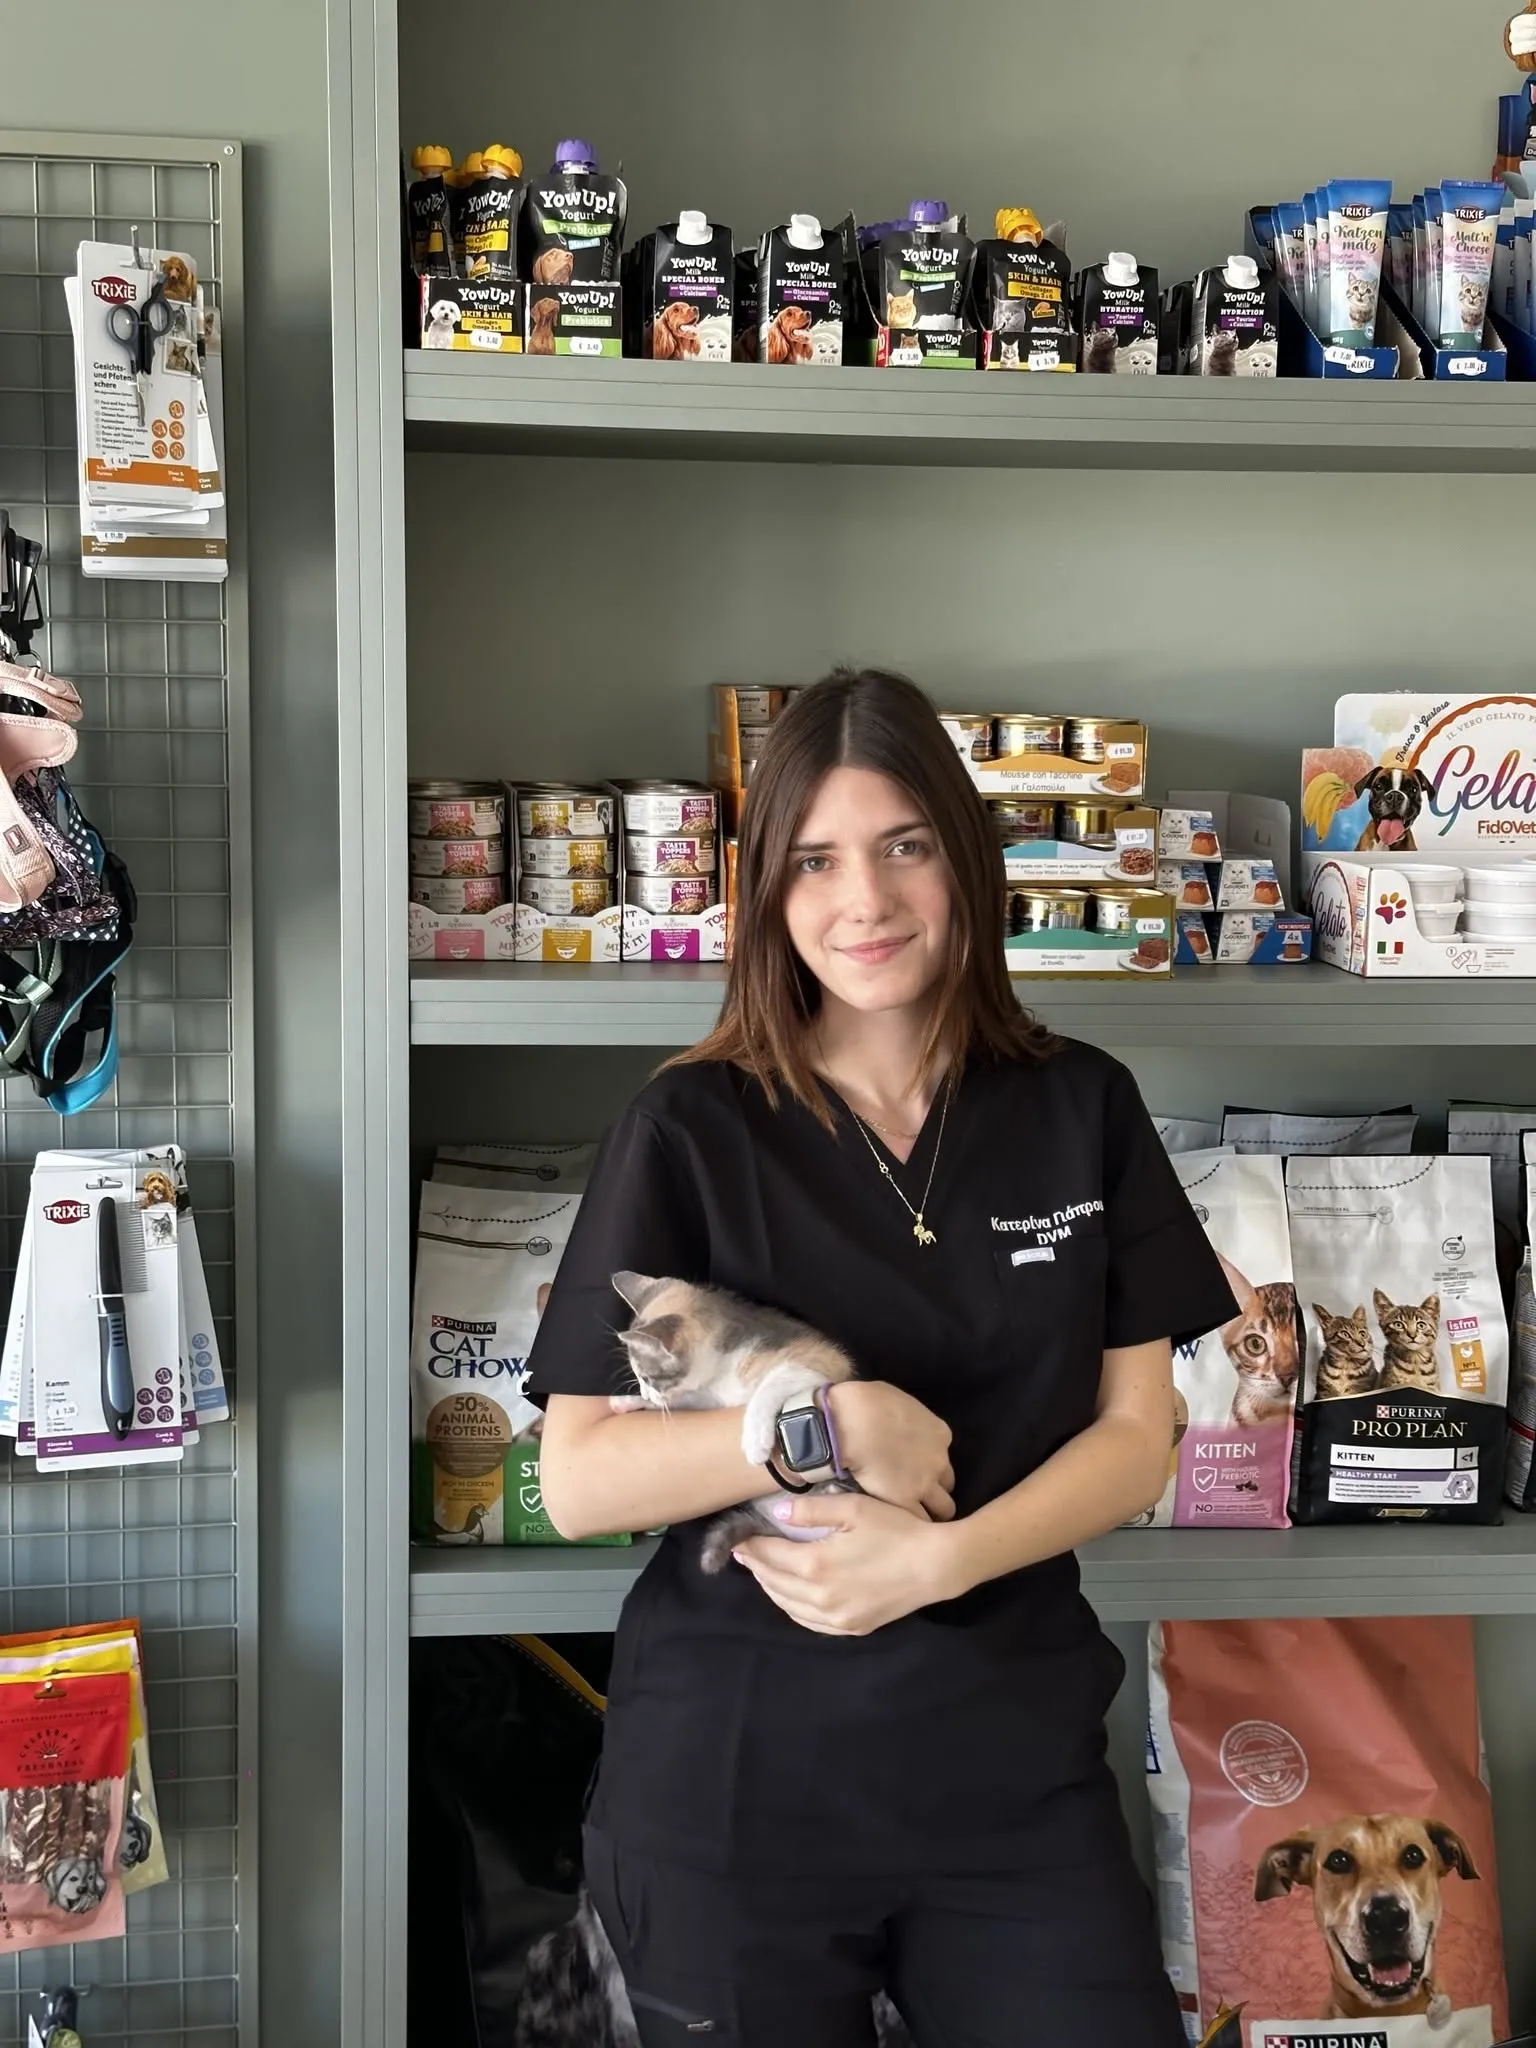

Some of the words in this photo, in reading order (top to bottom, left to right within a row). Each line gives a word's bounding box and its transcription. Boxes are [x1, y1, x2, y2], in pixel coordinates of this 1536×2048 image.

[468, 188, 514, 213] YowUp!
[540, 188, 616, 214] YowUp!
[560, 209, 595, 222] Yogurt
[1341, 206, 1372, 217] TRIXIE
[1455, 208, 1484, 219] TRIXIE
[1334, 225, 1383, 242] Katzen
[1342, 238, 1379, 254] malz
[1455, 242, 1491, 255] Cheese
[901, 248, 959, 265] YowUp!
[670, 256, 717, 271] YowUp!
[785, 261, 830, 276] YowUp!
[915, 262, 942, 272] Yogurt
[1024, 264, 1048, 275] Yogurt
[662, 275, 696, 283] SPECIAL
[776, 279, 810, 287] SPECIAL
[812, 281, 837, 289] BONES
[1007, 271, 1030, 282] SKIN
[1032, 275, 1039, 283] &
[1040, 276, 1062, 286] HAIR
[458, 287, 515, 306] YowUp!
[558, 290, 615, 309] YowUp!
[717, 294, 730, 304] 0%
[1102, 289, 1145, 302] YowUp!
[1223, 291, 1265, 304] YowUp!
[473, 302, 500, 311] Yogurt
[573, 305, 599, 314] Yogurt
[829, 300, 841, 309] 0%
[462, 310, 483, 318] SKIN
[491, 311, 513, 319] HAIR
[1143, 320, 1156, 329] 0%
[1263, 322, 1276, 332] 0%
[925, 334, 962, 345] YowUp!
[1032, 339, 1058, 347] YowUp!
[93, 362, 126, 372] Gesichts-
[1348, 359, 1373, 369] RIXIE
[108, 372, 135, 382] Pfoten-
[94, 381, 117, 389] schere
[1457, 717, 1482, 732] VERO
[1486, 712, 1526, 721] GELATO
[1000, 770, 1031, 779] Mousse
[1032, 772, 1047, 780] con
[1049, 771, 1083, 780] Tacchino
[1010, 784, 1020, 792] με
[1428, 744, 1536, 836] Gela
[491, 912, 513, 927] TOP
[599, 913, 621, 928] TOP
[705, 911, 726, 928] TOP
[632, 933, 647, 946] IT!
[1287, 932, 1299, 940] 4x
[714, 941, 726, 949] MI
[991, 1215, 1051, 1233] Κατερίνα
[1036, 1225, 1072, 1245] DVM
[447, 1320, 494, 1333] PURINA
[1449, 1318, 1476, 1331] isfm
[430, 1330, 494, 1357] CAT
[428, 1355, 527, 1379] CHOW
[453, 1396, 489, 1412] 50%
[440, 1413, 496, 1424] ANIMAL
[1390, 1407, 1443, 1419] PURINA
[435, 1425, 501, 1437] PROTEINS
[1352, 1419, 1402, 1437] PRO
[1406, 1421, 1465, 1439] PLAN
[1194, 1442, 1257, 1459] KITTEN
[1337, 1451, 1375, 1462] KITTEN
[1220, 1470, 1261, 1480] PREBIOTIC
[1335, 1469, 1372, 1479] HEALTHY
[1373, 1472, 1397, 1480] START
[1195, 1504, 1213, 1513] NO
[525, 1524, 545, 1533] NO
[1293, 2036, 1382, 2048] PURINA
